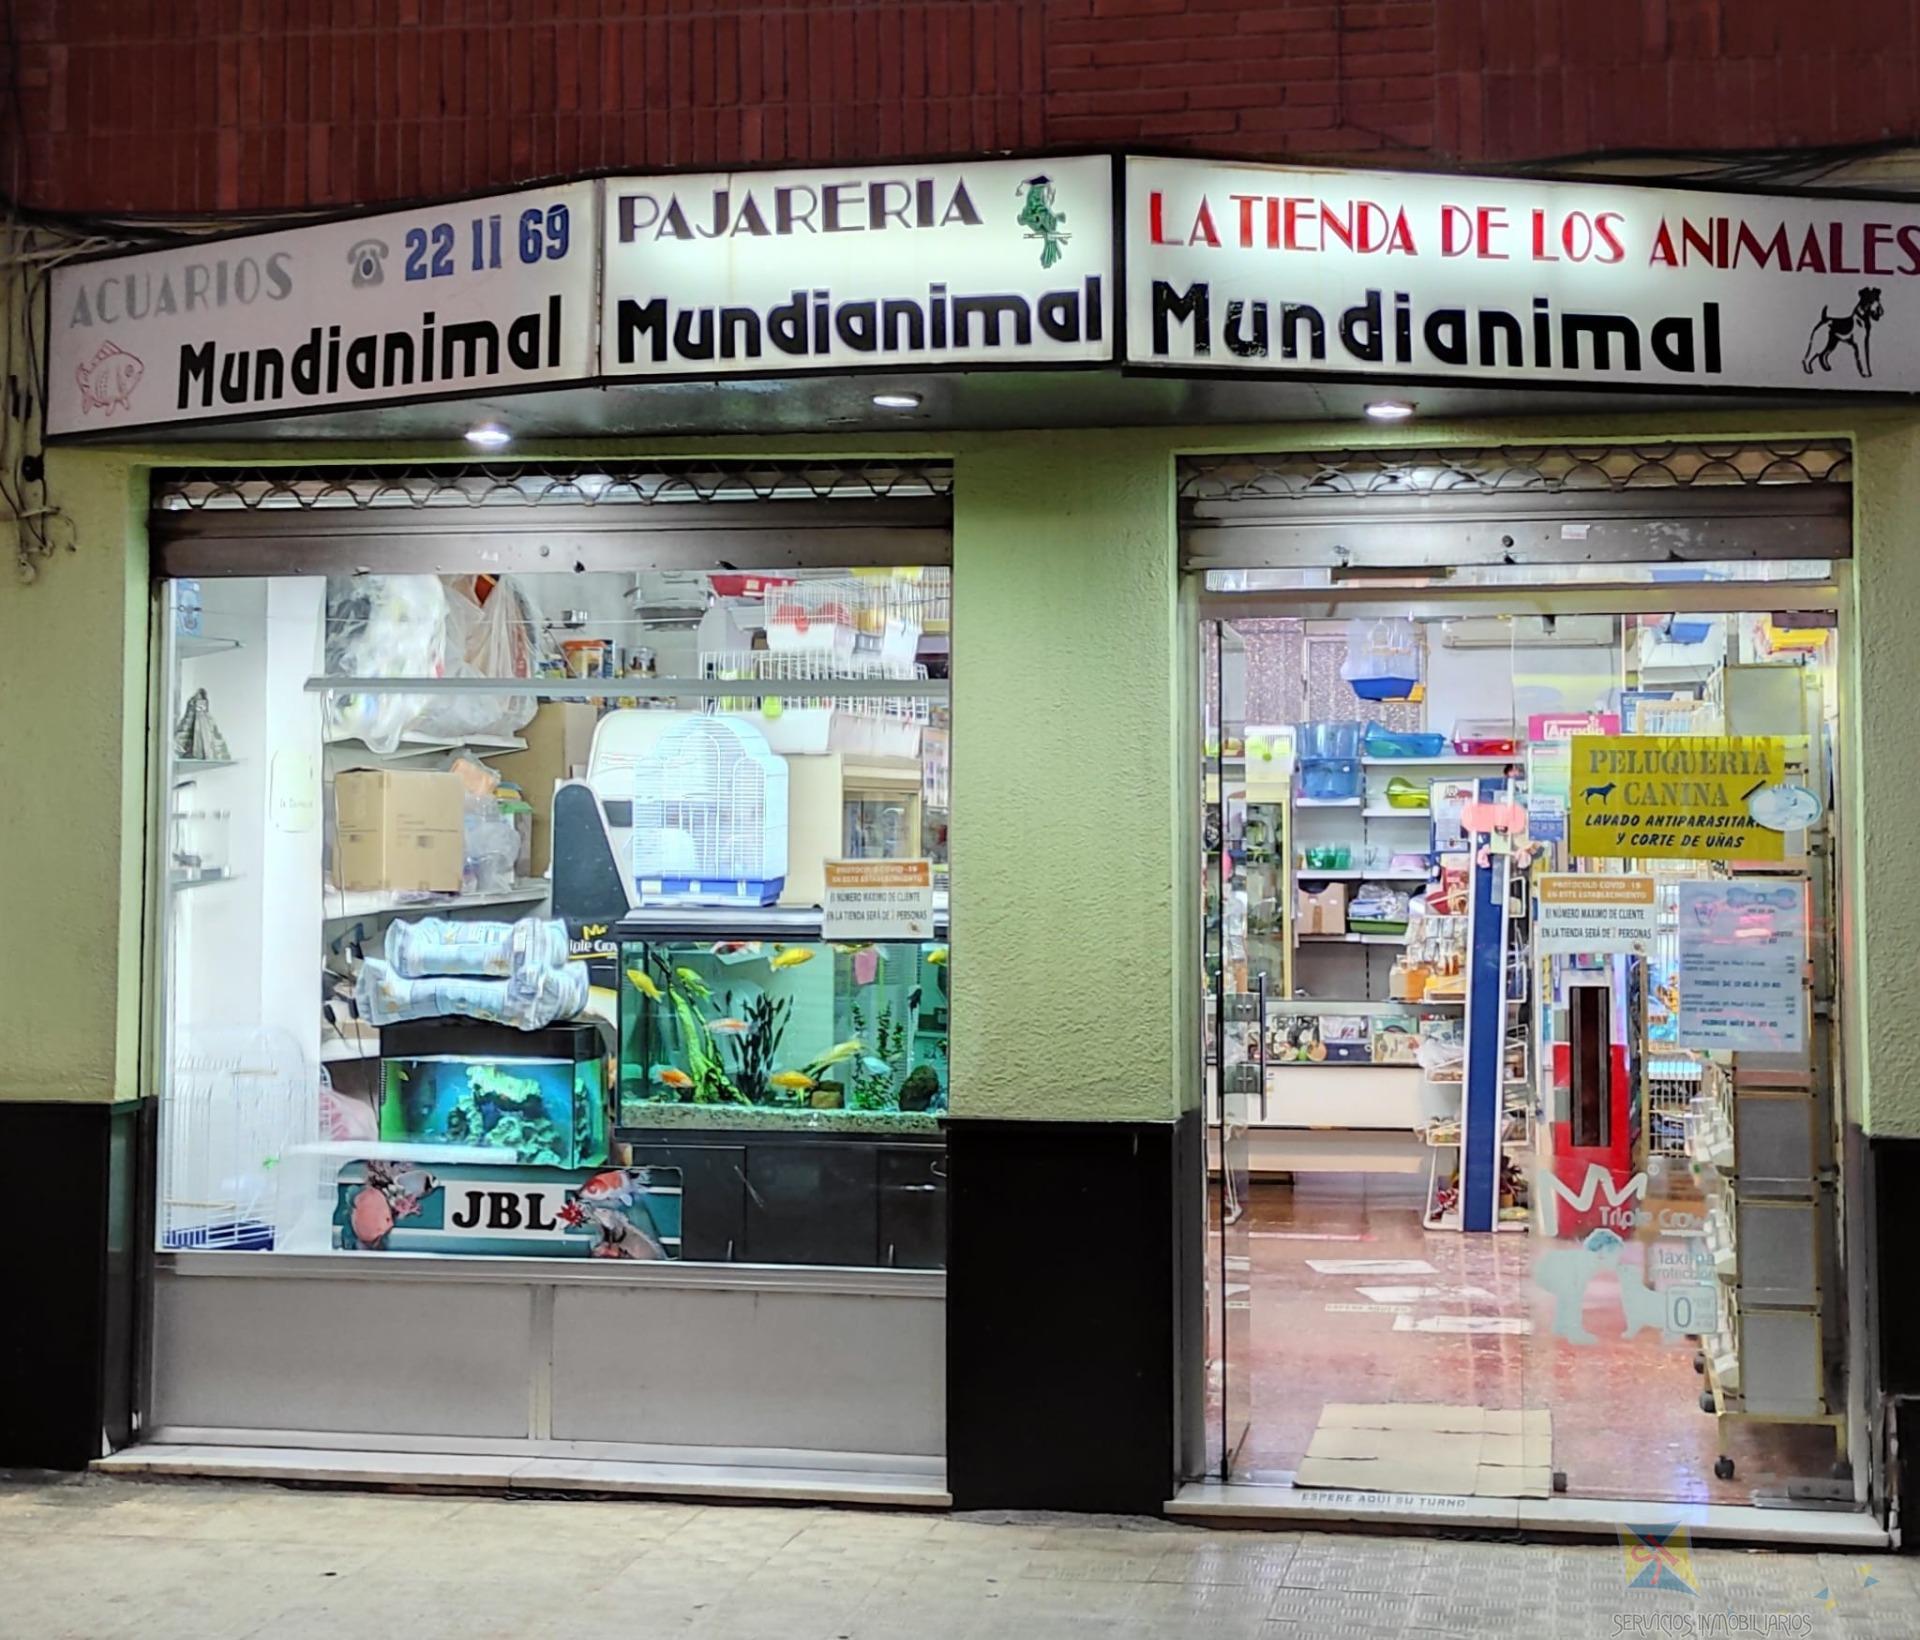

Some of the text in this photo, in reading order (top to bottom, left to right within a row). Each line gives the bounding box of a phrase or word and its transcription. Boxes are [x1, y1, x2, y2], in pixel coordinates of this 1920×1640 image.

[617, 176, 984, 243] PAJARERIA
[404, 222, 455, 282] 22
[518, 203, 571, 264] 69
[1149, 190, 1920, 277] LA TIENDA DE LOS ANIMALES
[69, 252, 293, 330] ACUARIOS
[617, 274, 1103, 364] Mundianimal
[1151, 279, 1723, 375] Mundianimal
[177, 295, 562, 411] Mundianimal
[1588, 749, 1772, 775] PELUQUERIA
[1623, 781, 1730, 808] CANINA
[1585, 813, 1640, 827] LAVADO
[1616, 832, 1745, 849] Y CORTE DE UÑAS
[1541, 927, 1550, 938] EN
[1551, 927, 1559, 938] LA
[1560, 927, 1583, 938] TIENDA
[1601, 928, 1610, 938] DE
[1618, 927, 1652, 939] PERSONAS
[1609, 909, 1618, 919] DE
[1619, 909, 1645, 920] CLIENTE
[452, 1191, 558, 1231] JBL
[1302, 1492, 1355, 1504] ESPERE
